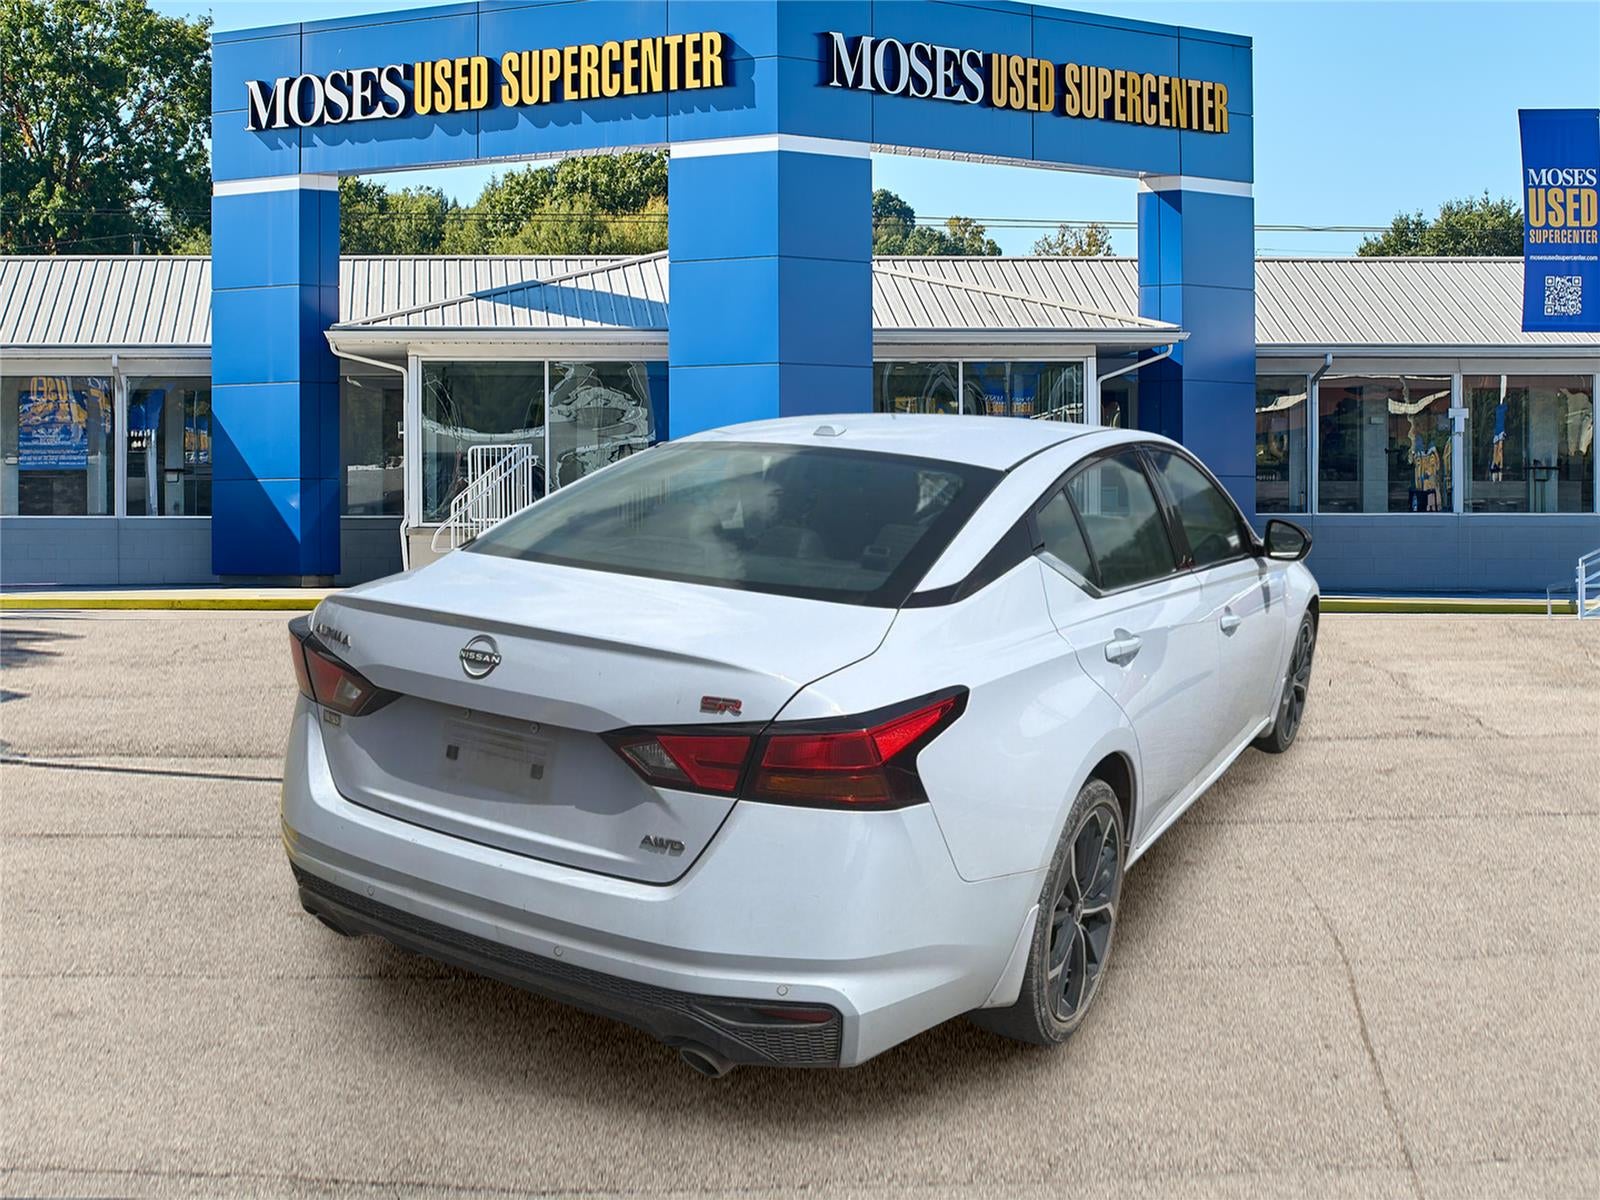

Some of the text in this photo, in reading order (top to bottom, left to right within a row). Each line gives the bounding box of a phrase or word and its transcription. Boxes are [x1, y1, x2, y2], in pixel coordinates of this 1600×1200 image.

[244, 31, 724, 132] MOSES USED SUPERCENTER
[829, 32, 1229, 133] MOSES USED SUPERCENTER
[1527, 168, 1597, 187] MOSES
[1528, 188, 1598, 228] USED
[1529, 229, 1598, 245] SUPERCENTER
[460, 649, 501, 665] NISSAN
[699, 696, 742, 717] SR
[639, 834, 685, 857] AWD
